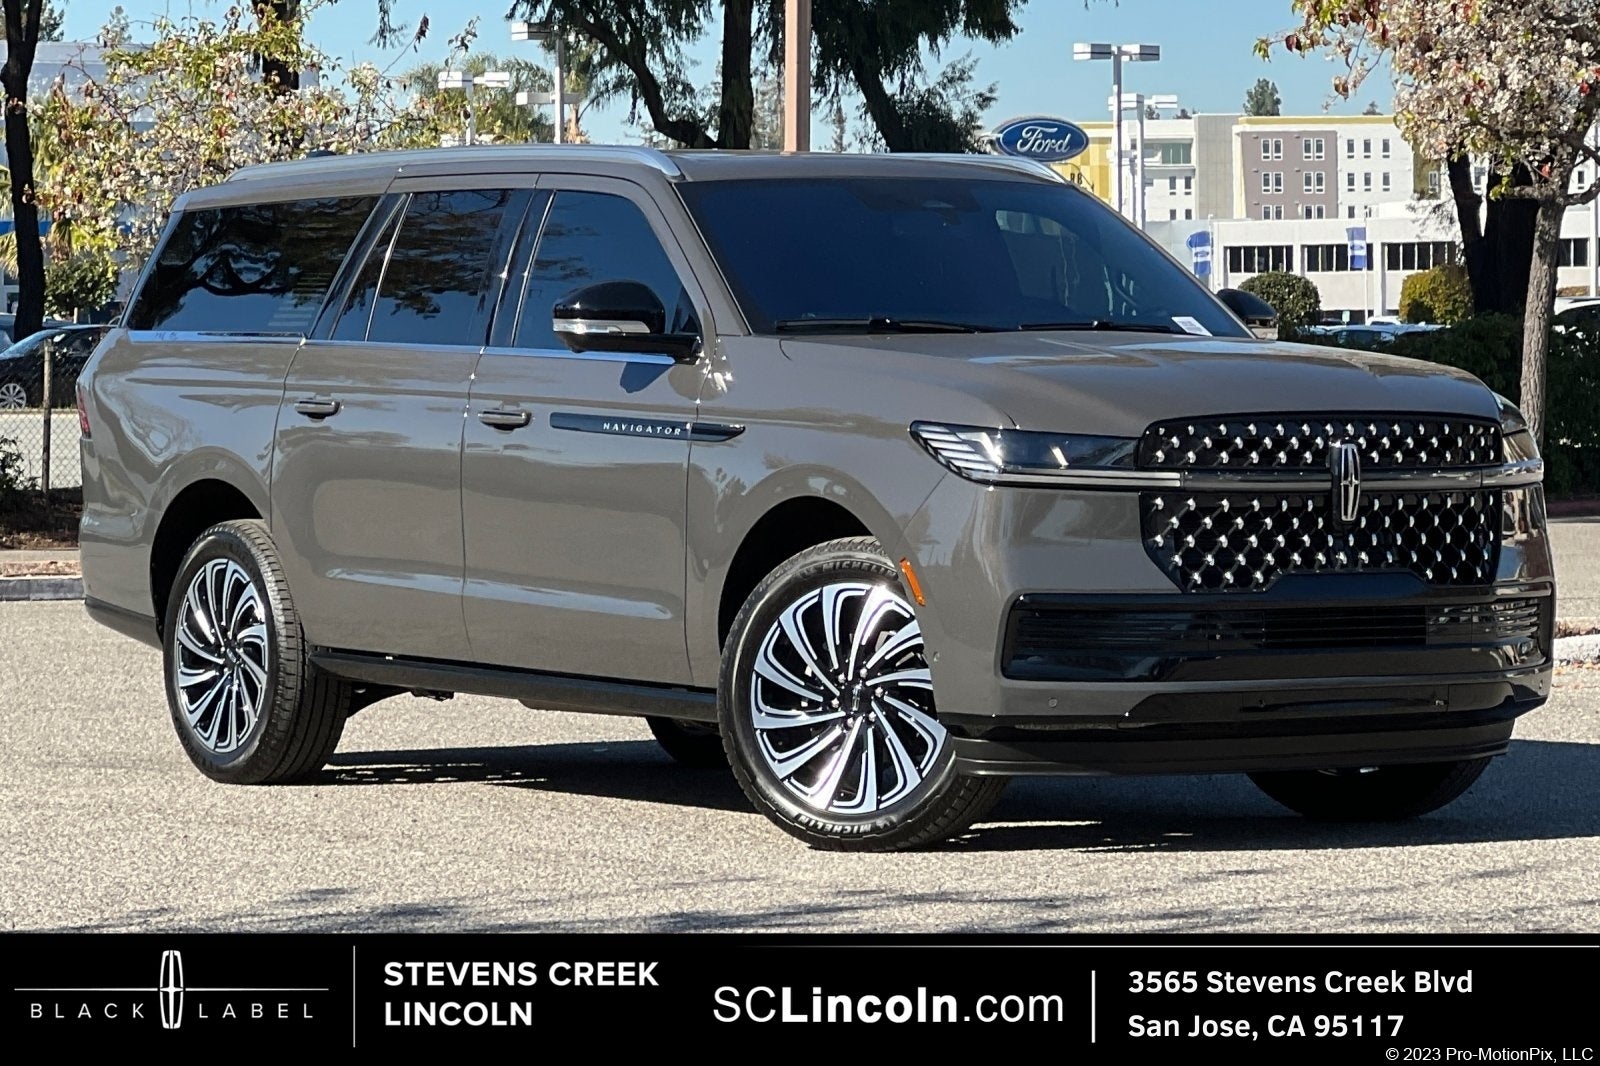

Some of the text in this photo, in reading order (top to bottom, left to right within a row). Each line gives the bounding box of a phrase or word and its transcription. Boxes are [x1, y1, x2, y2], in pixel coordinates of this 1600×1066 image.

[1016, 125, 1072, 153] Ford
[603, 422, 681, 436] NAVIGATOR
[822, 561, 897, 577] MICHELIN
[798, 815, 872, 834] MICHELIN
